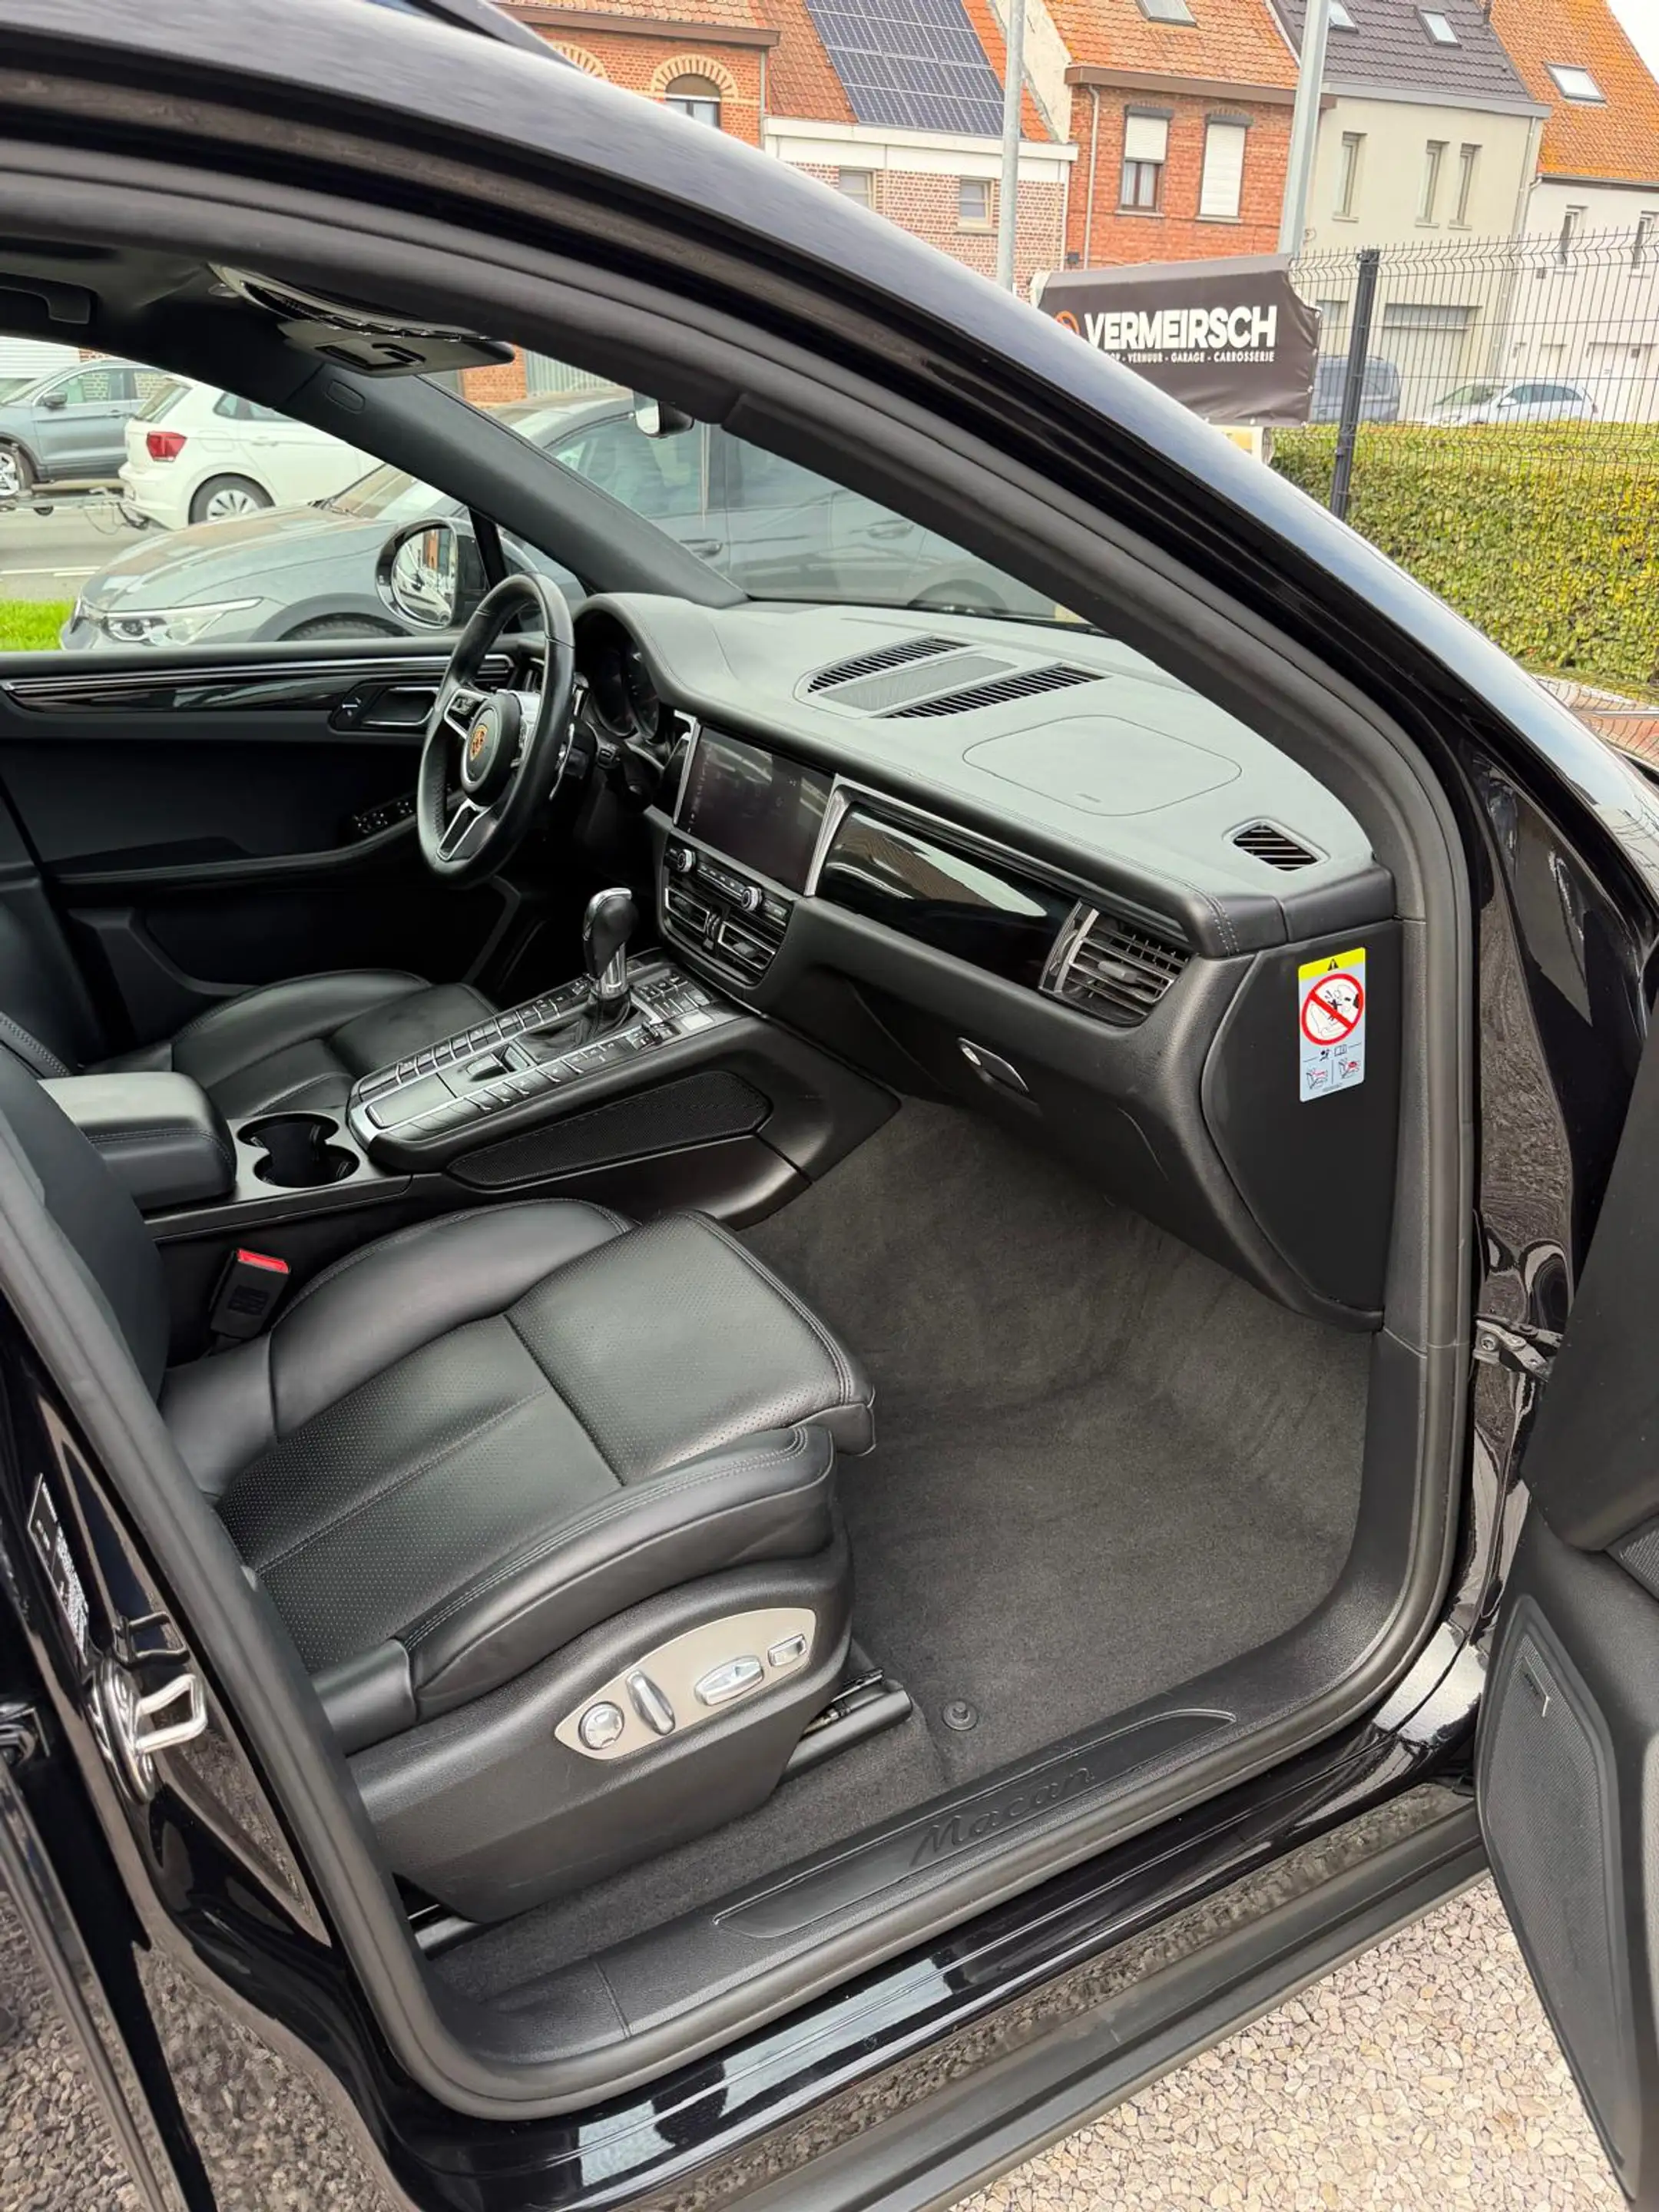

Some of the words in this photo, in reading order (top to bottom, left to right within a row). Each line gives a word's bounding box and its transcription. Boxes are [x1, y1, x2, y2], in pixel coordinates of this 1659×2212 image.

[1084, 305, 1277, 349] VERMEIRSCH
[1171, 351, 1205, 363] GARAGE
[1214, 350, 1275, 362] CARROSSERIE
[909, 1767, 1094, 1867] Macan
